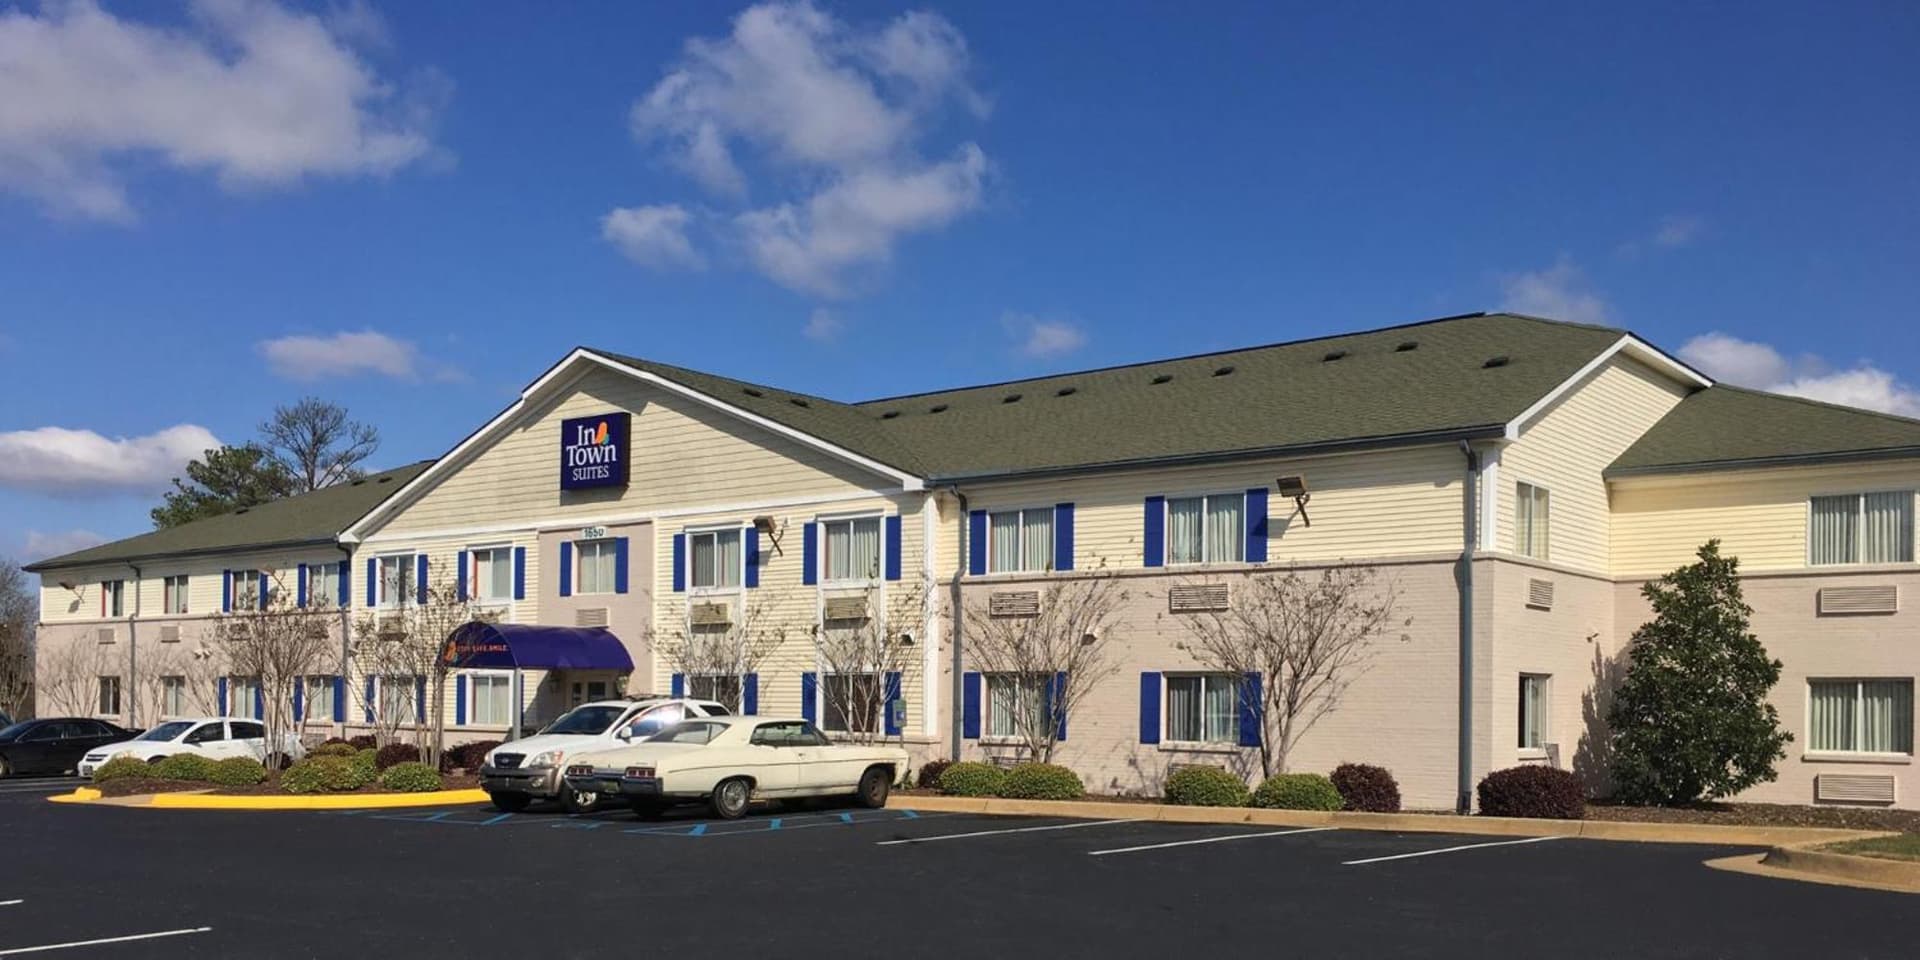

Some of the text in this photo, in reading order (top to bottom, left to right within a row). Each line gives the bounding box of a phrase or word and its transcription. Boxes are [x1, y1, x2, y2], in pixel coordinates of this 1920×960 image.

[577, 425, 596, 446] In
[566, 444, 616, 466] Town
[573, 465, 609, 481] SUITES
